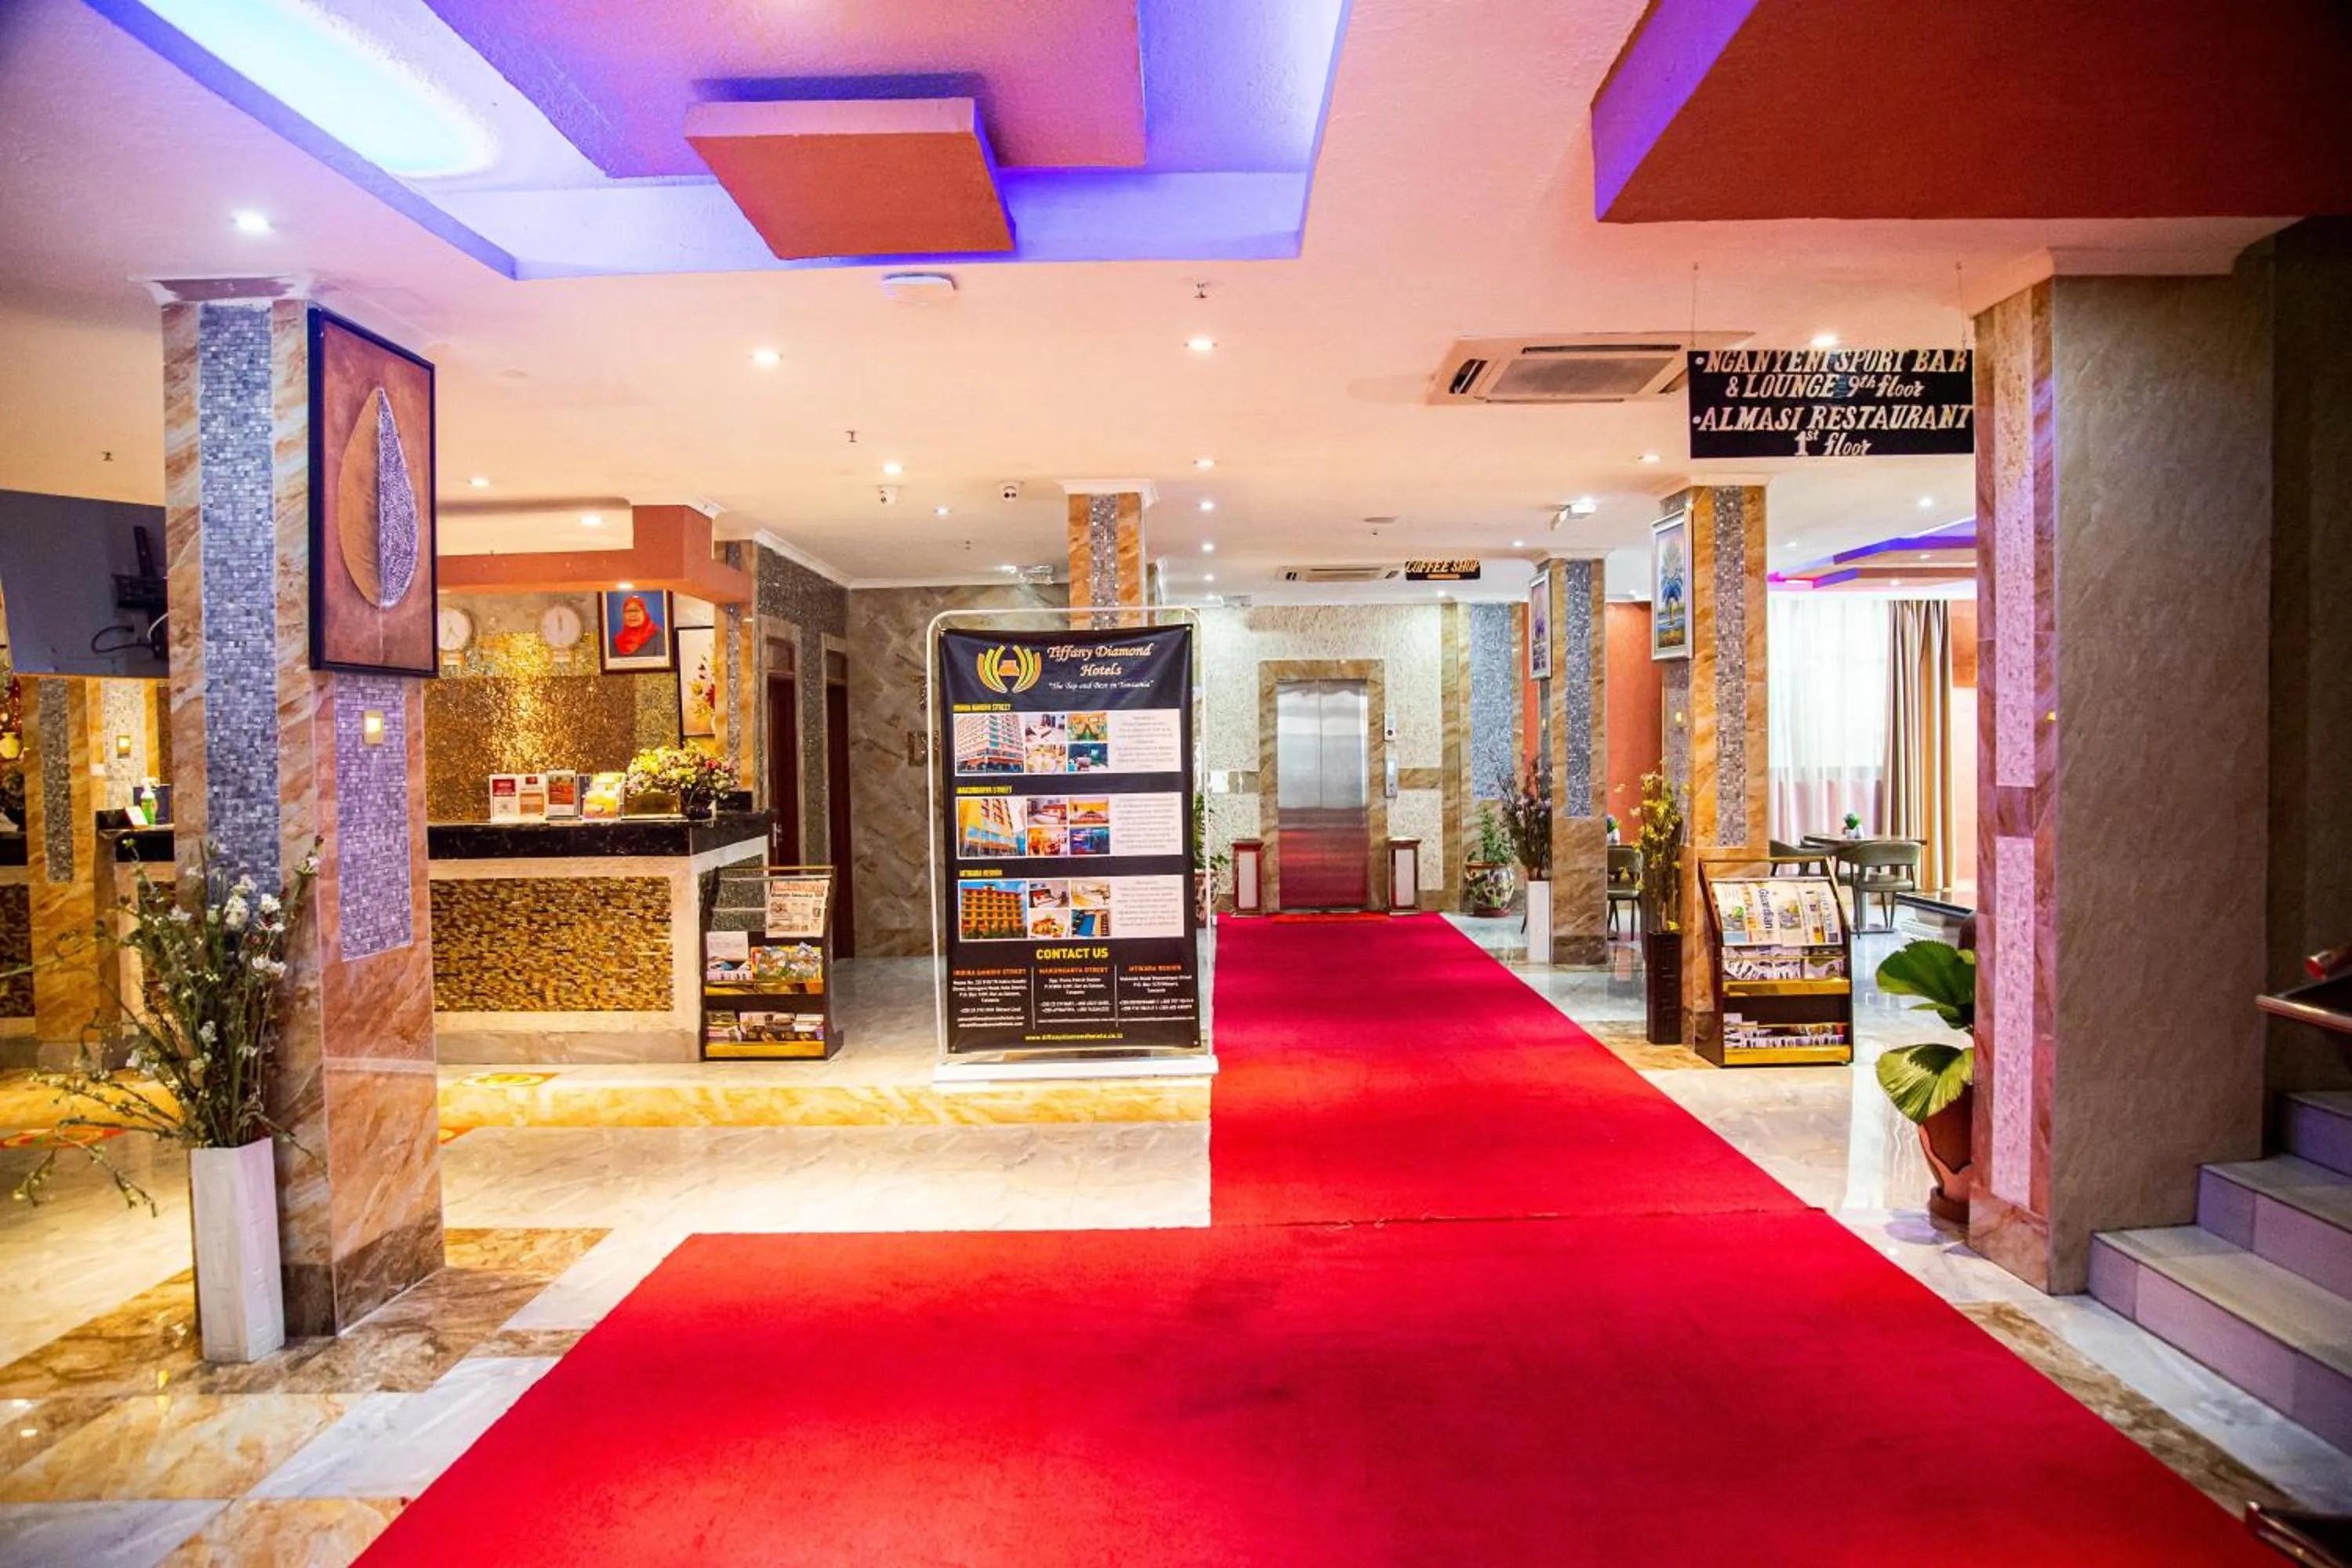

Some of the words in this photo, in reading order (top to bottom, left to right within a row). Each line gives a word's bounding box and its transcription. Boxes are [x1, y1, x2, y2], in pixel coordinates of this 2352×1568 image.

[1834, 350, 1904, 372] SPORT
[1911, 350, 1967, 372] BAR
[1726, 376, 1739, 397] &
[1742, 374, 1839, 397] LOUNGE
[1846, 375, 1876, 397] 9th
[1698, 406, 1805, 431] ALMASI
[1806, 405, 1973, 430] RESTAURANT
[1794, 430, 1820, 456] 1st
[1406, 561, 1450, 572] COFFEE
[1450, 558, 1479, 572] SHOP
[1047, 644, 1093, 662] Tiffany
[1095, 642, 1154, 657] Diamond
[1080, 662, 1122, 677] Hotels
[1759, 888, 1773, 929] Guardian
[1036, 948, 1090, 960] CONTACT
[1092, 946, 1109, 959] US
